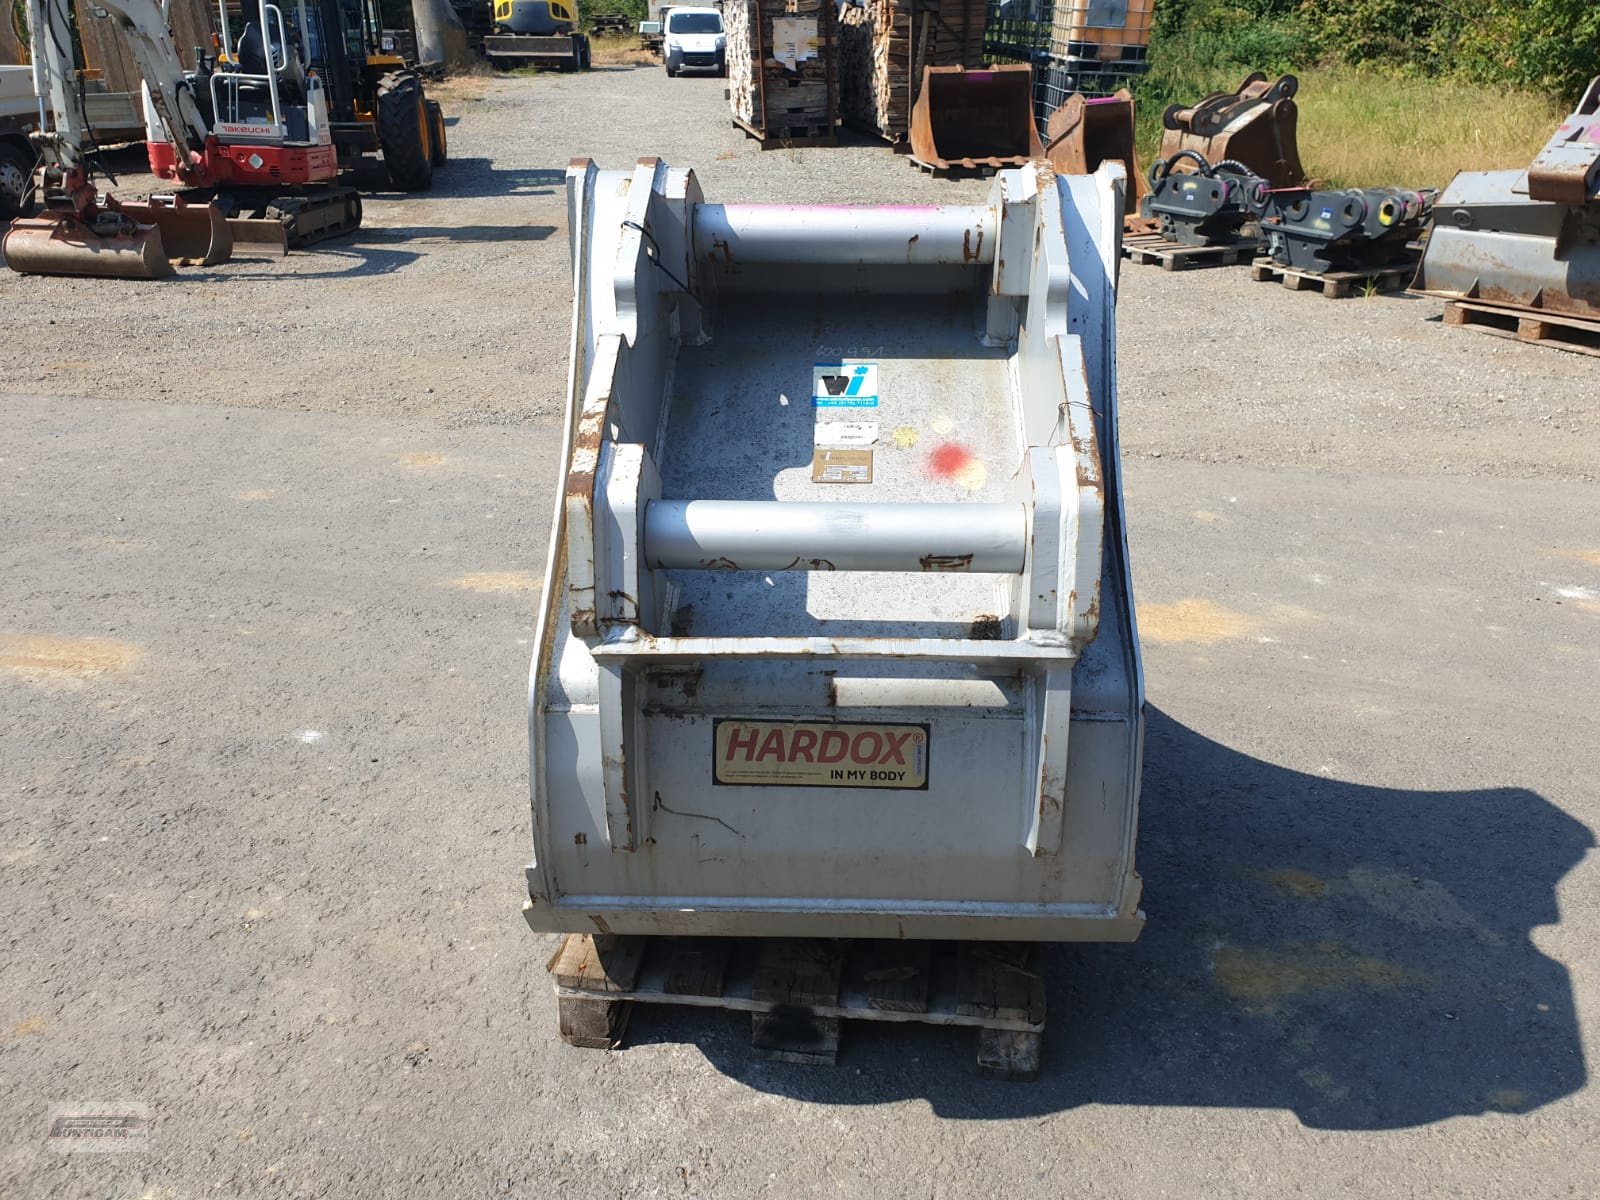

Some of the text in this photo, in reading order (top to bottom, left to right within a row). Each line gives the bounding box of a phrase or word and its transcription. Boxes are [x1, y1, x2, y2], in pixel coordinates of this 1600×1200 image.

[725, 728, 912, 766] HARDOX
[830, 769, 844, 780] IN
[847, 770, 867, 781] MY
[870, 770, 906, 782] BODY
